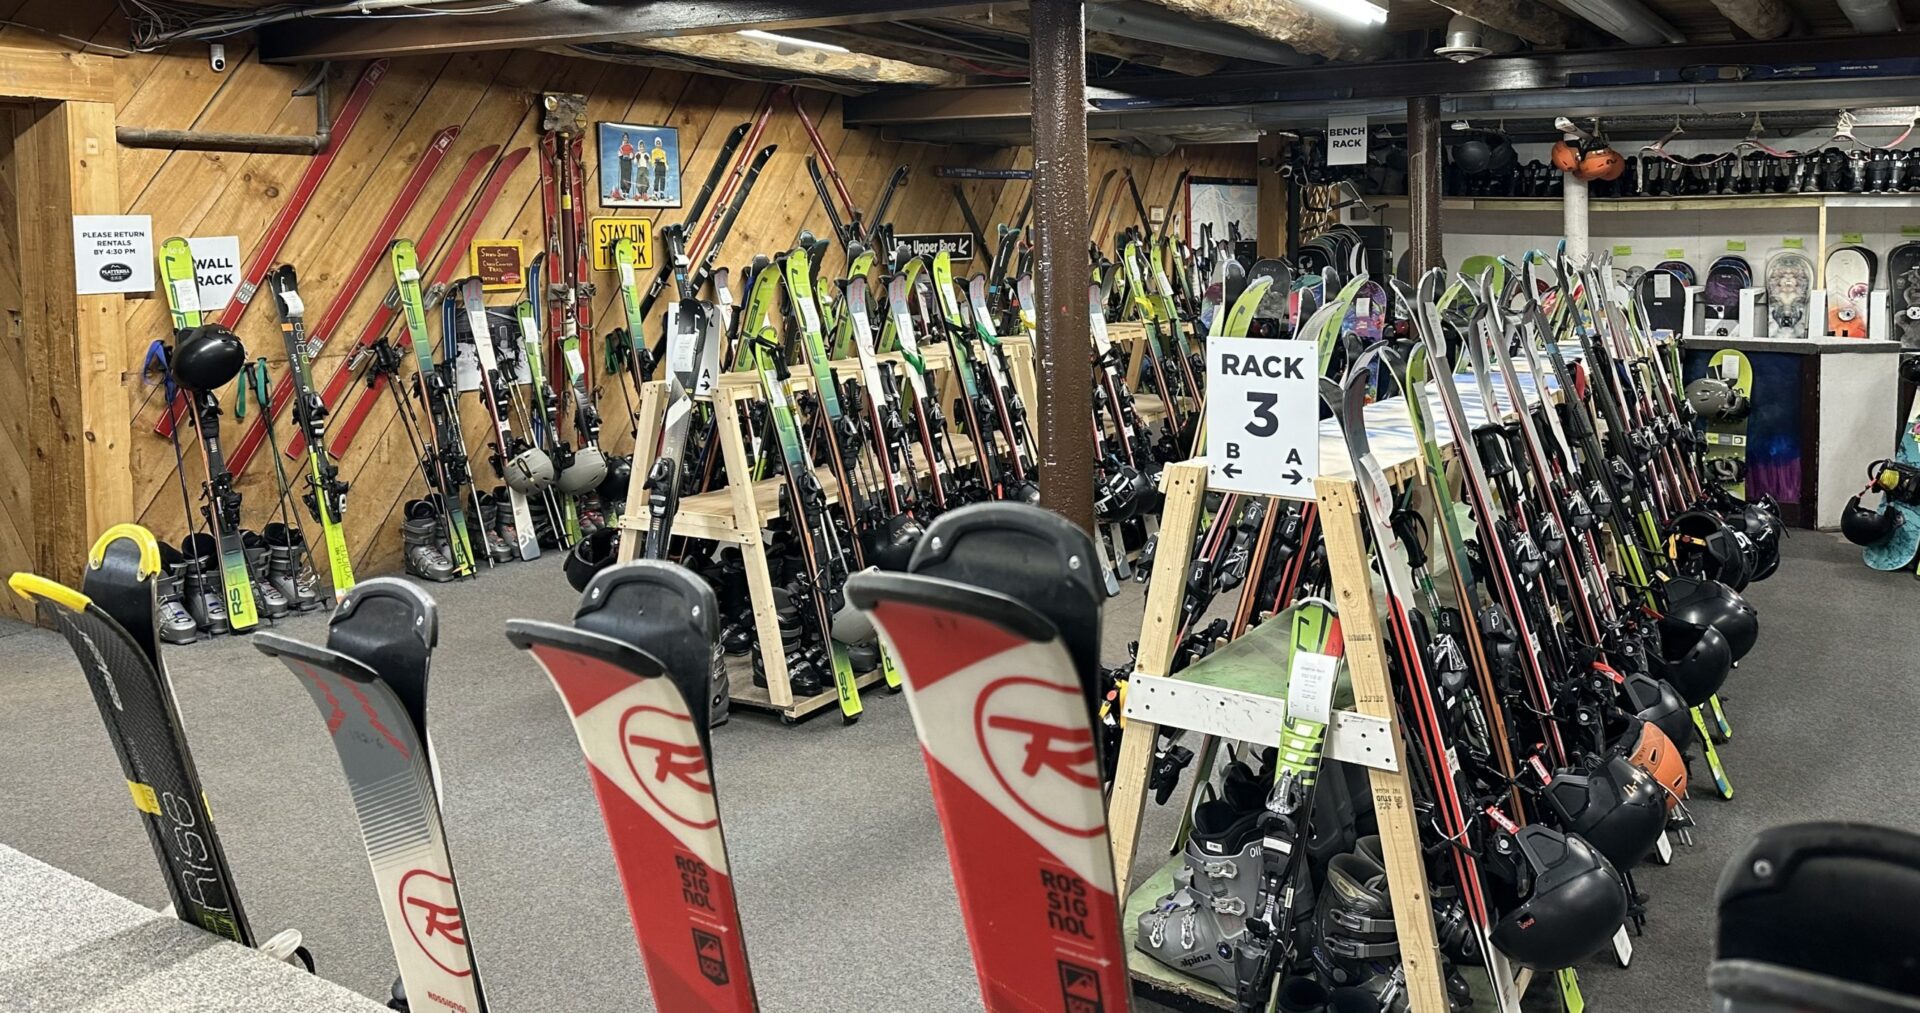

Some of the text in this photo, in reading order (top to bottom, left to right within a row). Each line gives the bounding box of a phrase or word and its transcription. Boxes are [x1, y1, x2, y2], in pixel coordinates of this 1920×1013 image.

[1329, 127, 1366, 137] BENCH
[1332, 139, 1362, 148] RACK
[599, 224, 645, 243] STAY ON
[599, 245, 646, 265] TCK
[913, 239, 938, 254] Upper
[939, 239, 956, 252] Face
[195, 257, 233, 270] WALL
[197, 274, 234, 287] RACK
[702, 368, 711, 379] A
[1221, 353, 1305, 380] RACK
[1244, 391, 1279, 438] 3
[1226, 442, 1303, 466] B A
[228, 587, 244, 617] RS
[839, 671, 851, 702] RS
[675, 855, 708, 877] ROS
[681, 872, 710, 893] SIG
[1040, 868, 1087, 897] ROS
[1048, 891, 1089, 919] SIG
[1180, 953, 1212, 968] alpina
